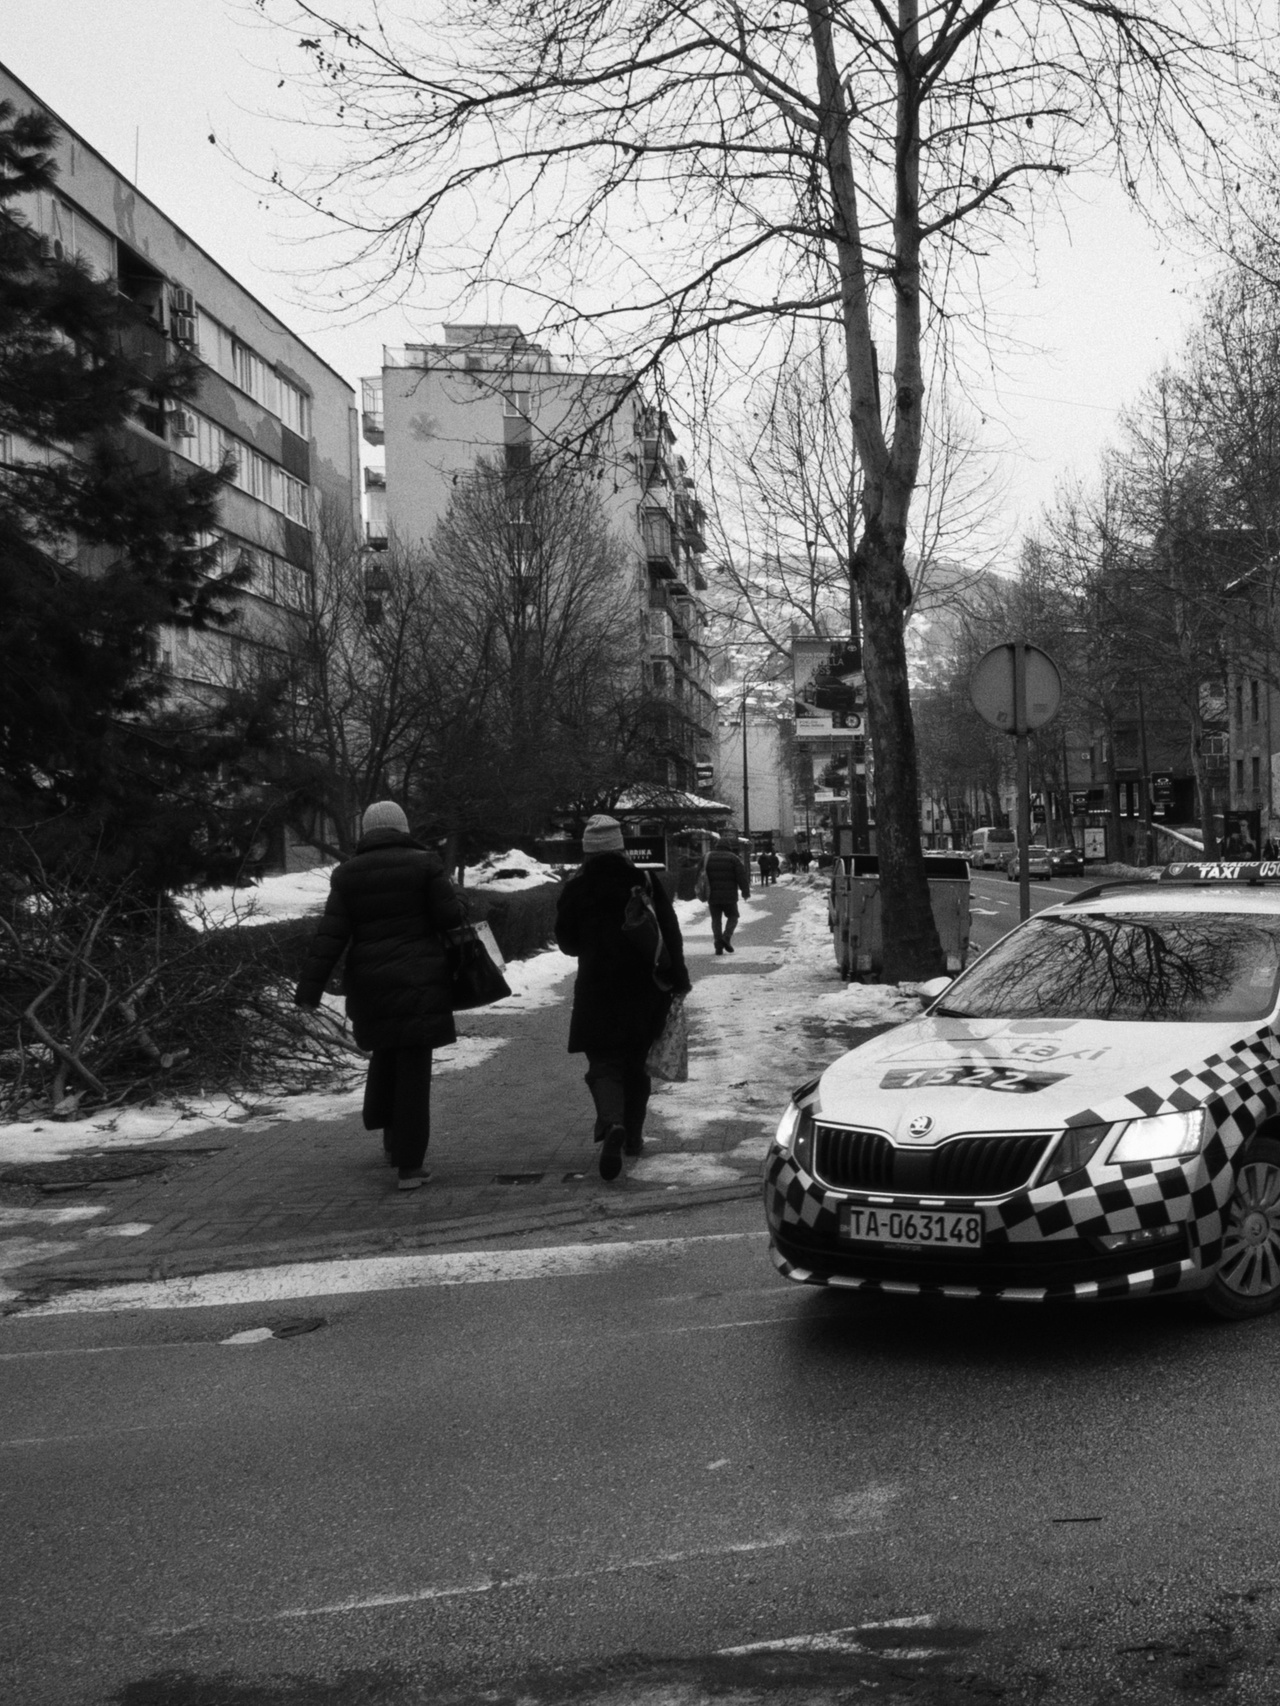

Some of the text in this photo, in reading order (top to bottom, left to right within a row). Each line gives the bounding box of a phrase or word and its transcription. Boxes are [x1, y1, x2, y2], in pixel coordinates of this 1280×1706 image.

[1199, 867, 1241, 879] TAXI
[1010, 1041, 1112, 1062] taxi
[901, 1067, 1028, 1089] 1522
[851, 1209, 980, 1244] TA-063148
